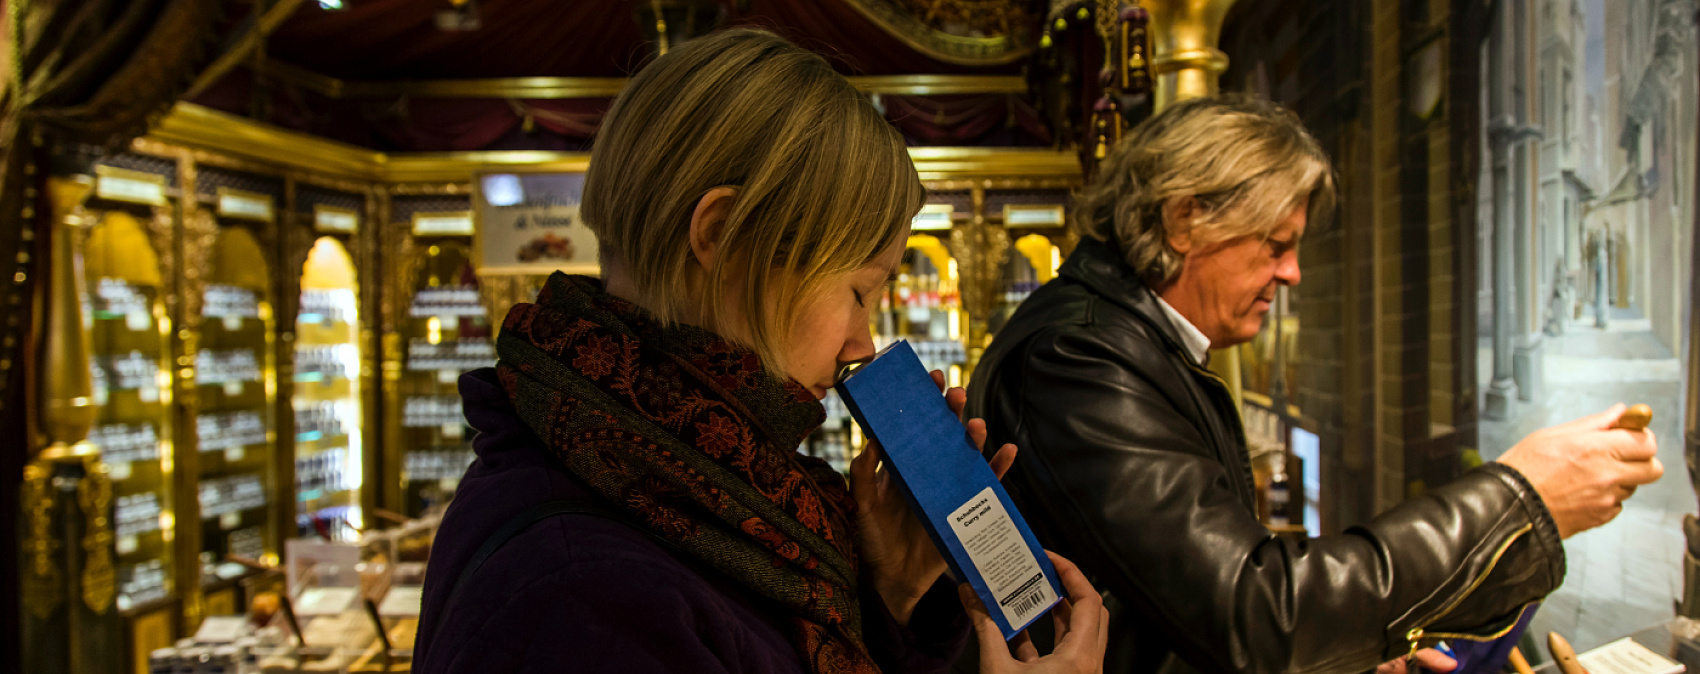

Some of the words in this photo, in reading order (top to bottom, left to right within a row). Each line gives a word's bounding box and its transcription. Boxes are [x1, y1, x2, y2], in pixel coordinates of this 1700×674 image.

[957, 498, 988, 522] Schuhbecks
[964, 515, 980, 527] Curry
[979, 505, 992, 516] mild
